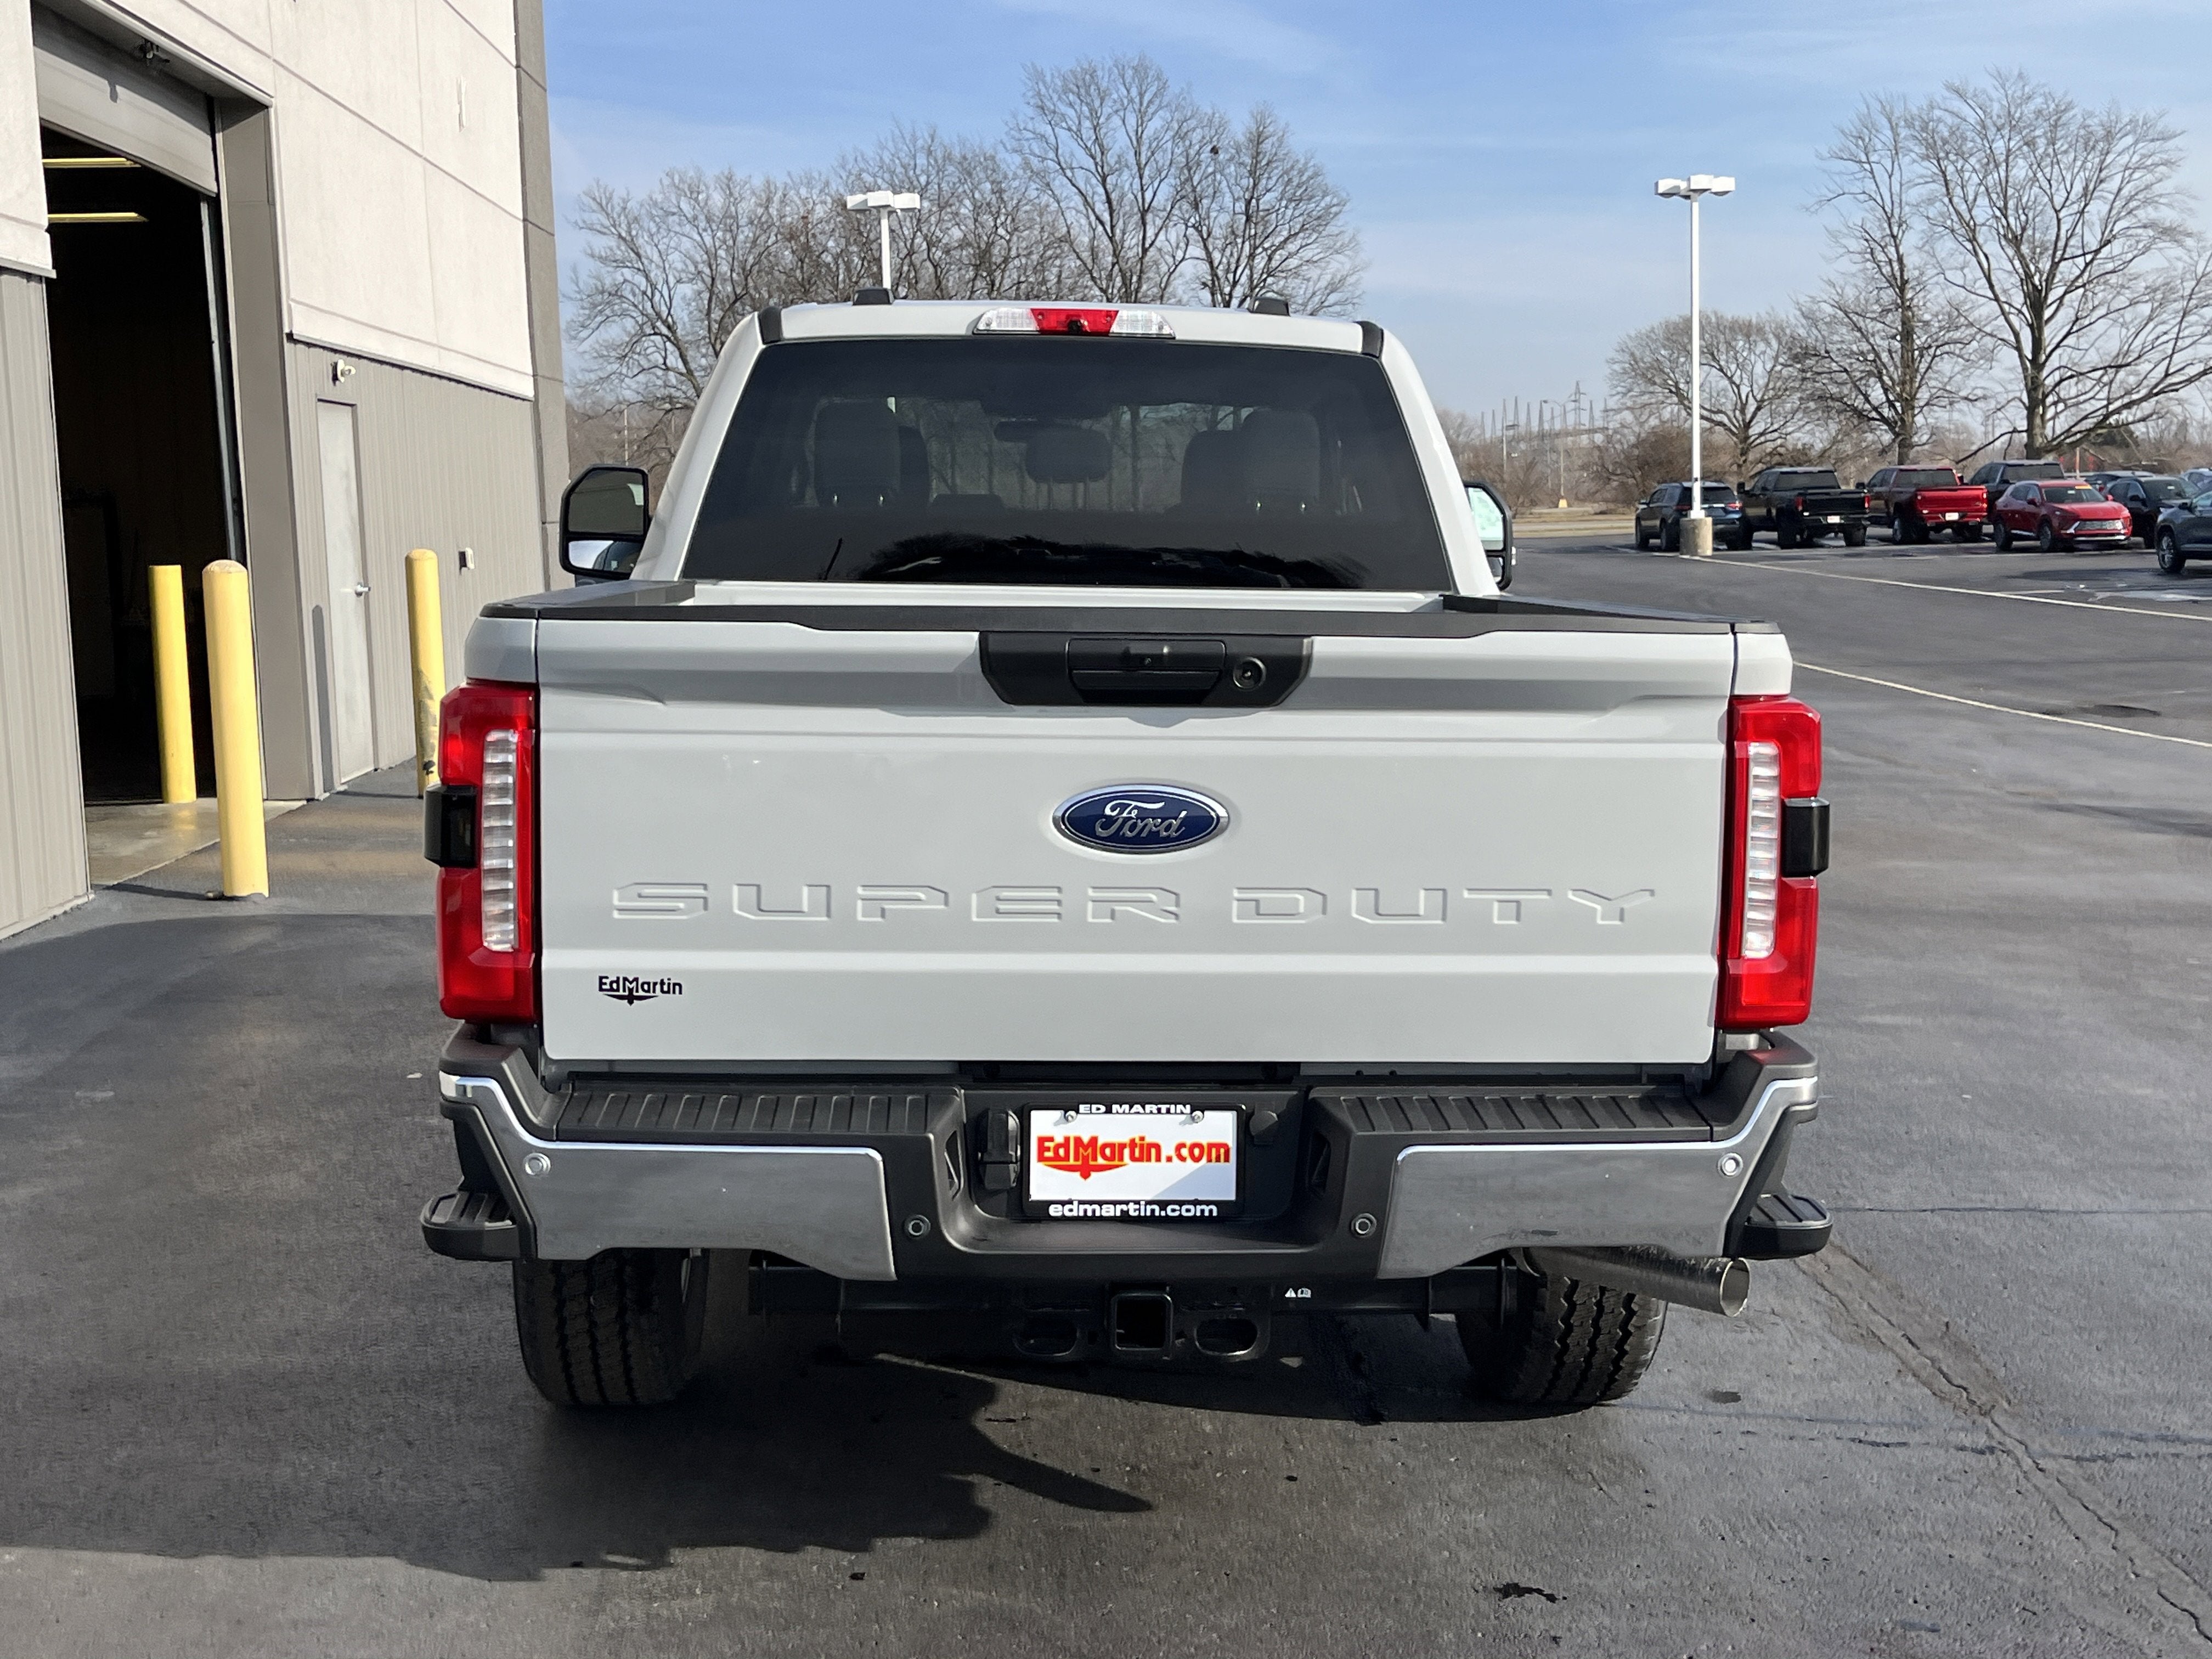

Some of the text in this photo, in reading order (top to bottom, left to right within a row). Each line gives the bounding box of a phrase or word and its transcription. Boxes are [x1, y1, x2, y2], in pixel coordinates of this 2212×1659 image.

[1094, 799, 1186, 837] Ford
[612, 882, 1656, 924] SUPER DUTY
[1079, 1104, 1191, 1114] ED MARTIN
[1048, 1200, 1218, 1217] edmartin.com
